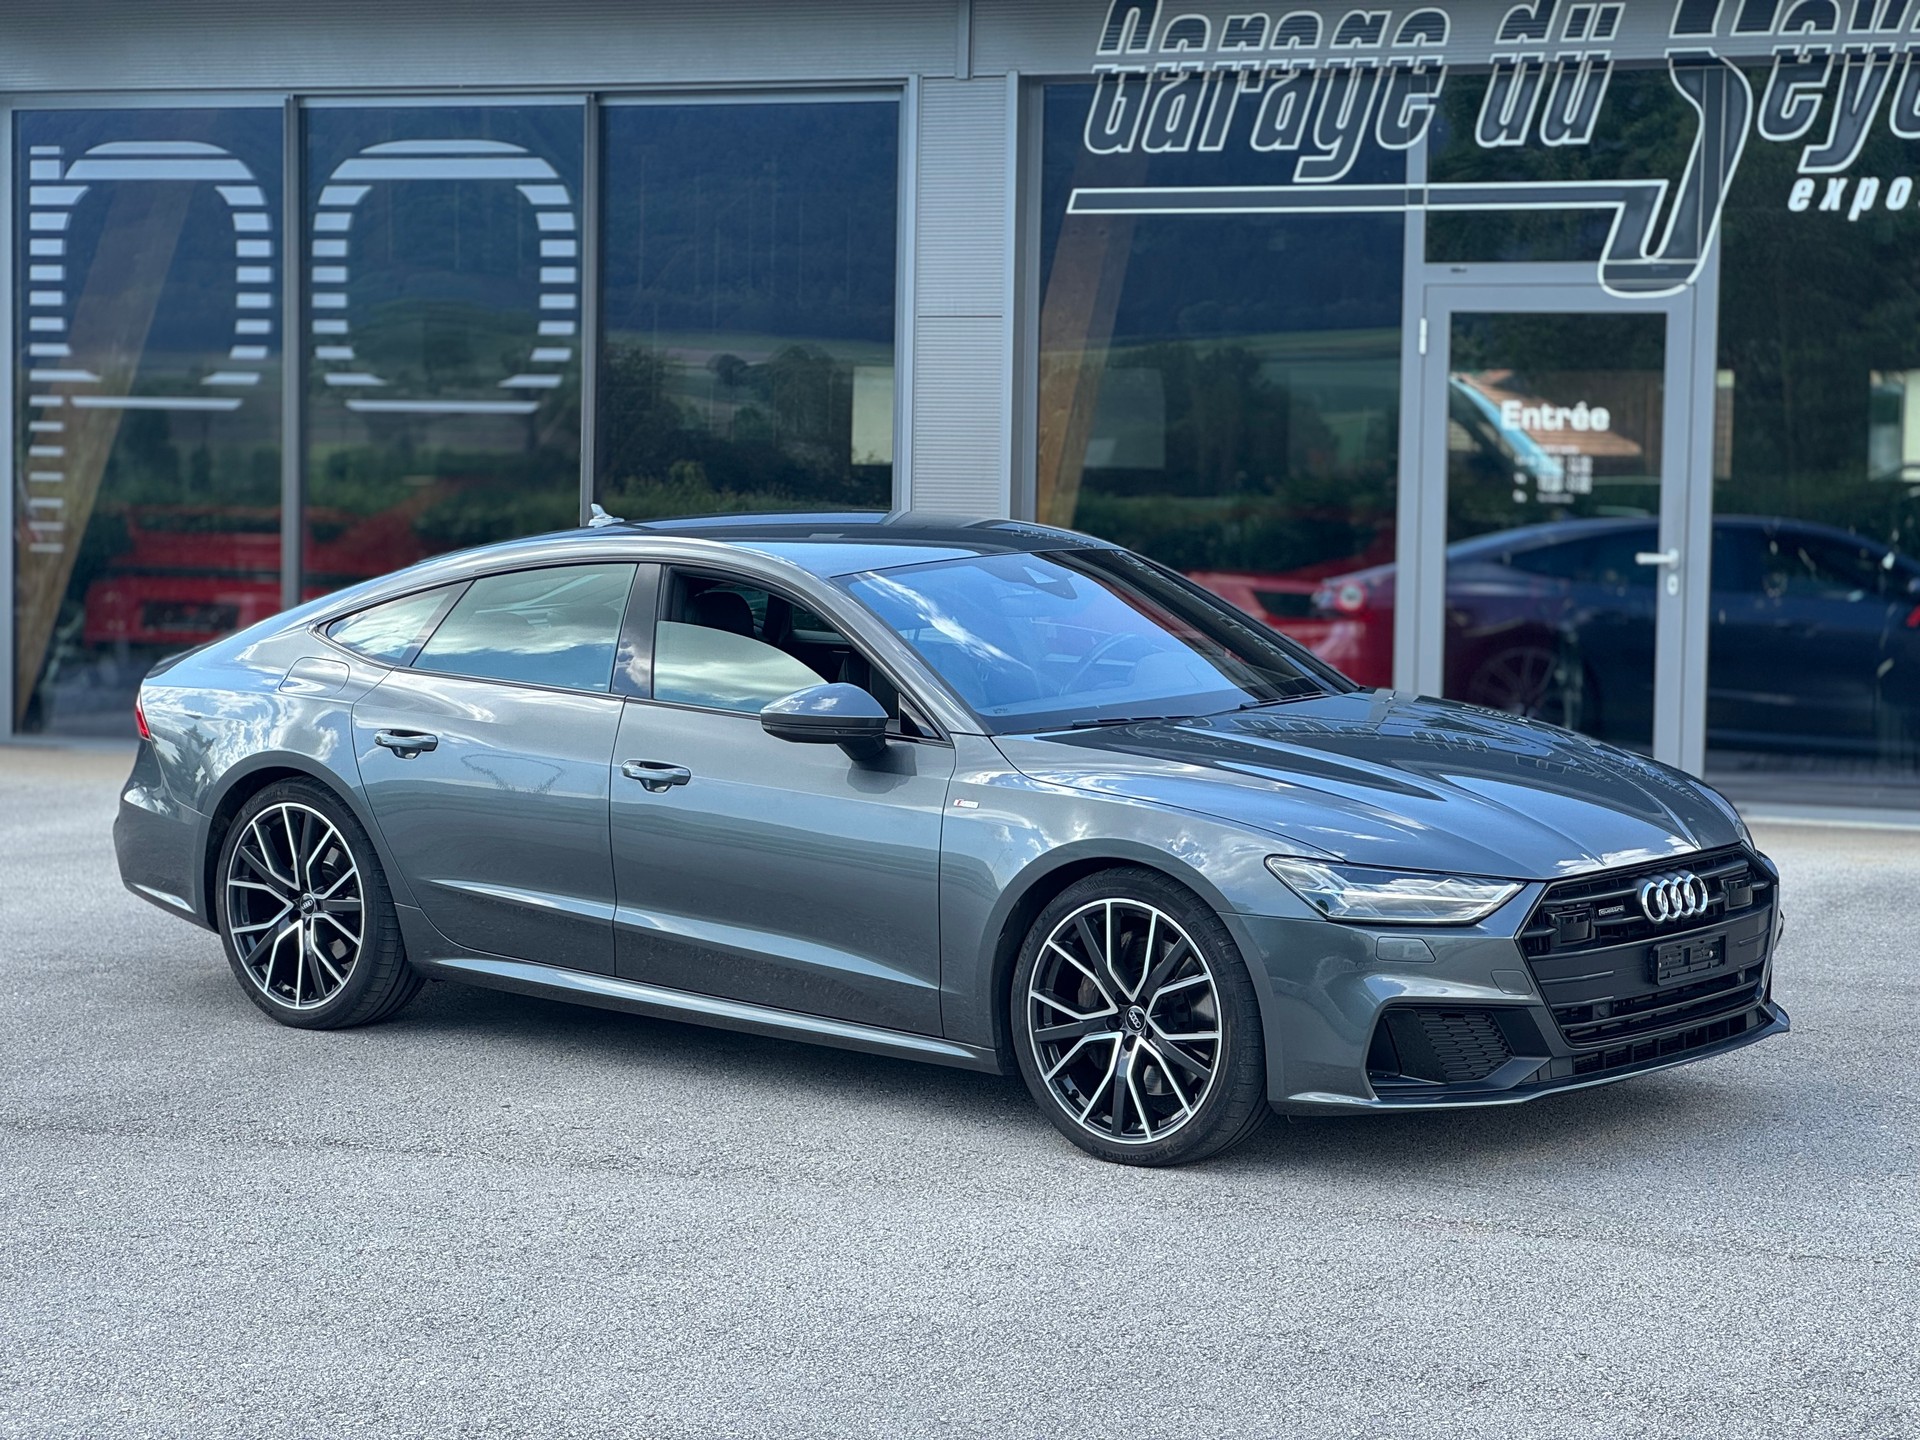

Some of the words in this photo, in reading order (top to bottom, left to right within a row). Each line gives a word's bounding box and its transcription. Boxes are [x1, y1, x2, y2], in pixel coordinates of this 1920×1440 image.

[1083, 0, 1452, 184] Garage
[1475, 0, 1627, 149] du
[1787, 176, 1919, 222] expo
[1500, 399, 1610, 432] Entrée
